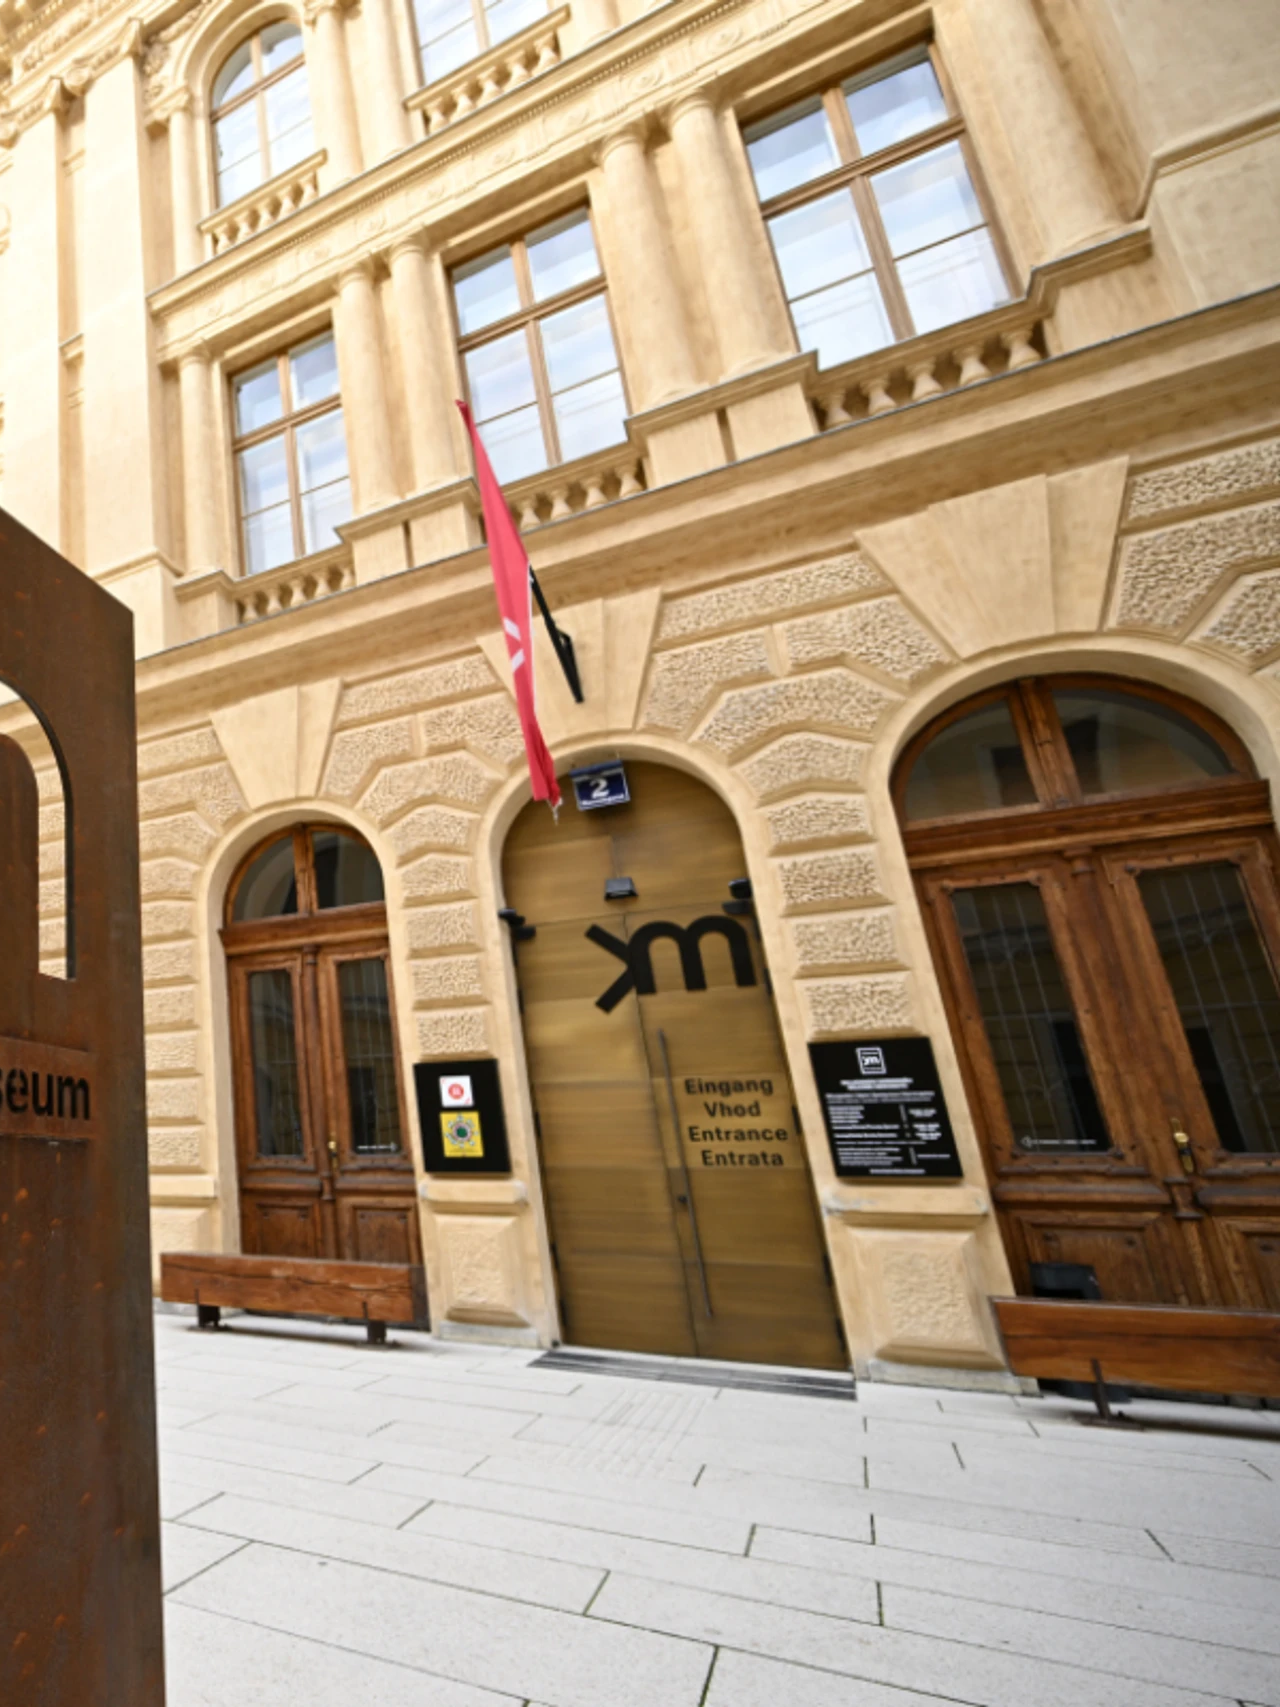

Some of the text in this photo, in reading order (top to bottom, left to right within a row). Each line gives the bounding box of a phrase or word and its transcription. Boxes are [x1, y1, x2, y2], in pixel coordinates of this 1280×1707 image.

[590, 778, 610, 799] 2
[684, 1077, 773, 1096] Eingang
[703, 1100, 761, 1117] Vhod
[688, 1125, 789, 1142] Entrance
[701, 1149, 784, 1167] Entrata
